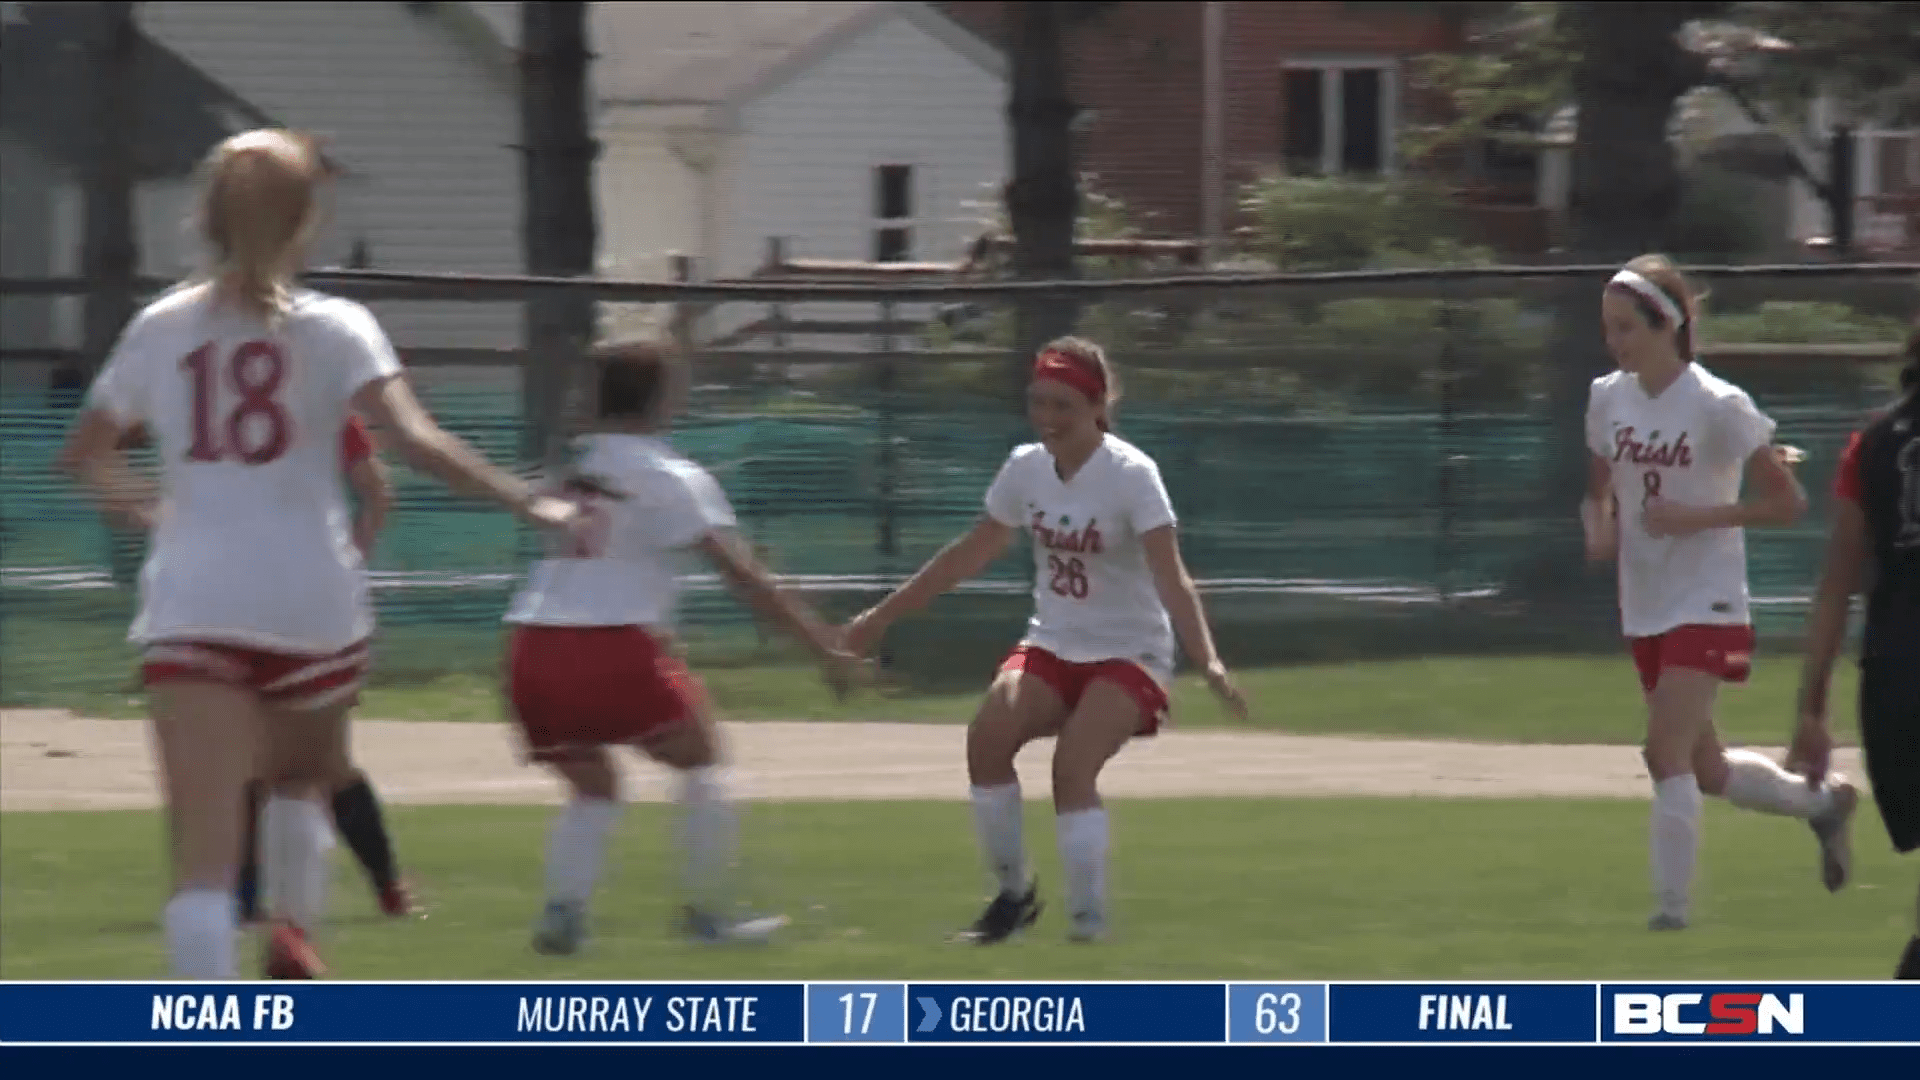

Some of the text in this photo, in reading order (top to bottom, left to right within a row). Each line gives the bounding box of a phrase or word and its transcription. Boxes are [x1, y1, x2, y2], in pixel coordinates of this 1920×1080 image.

[177, 339, 292, 465] 18
[1613, 426, 1691, 467] Irish
[1048, 554, 1088, 599] 26
